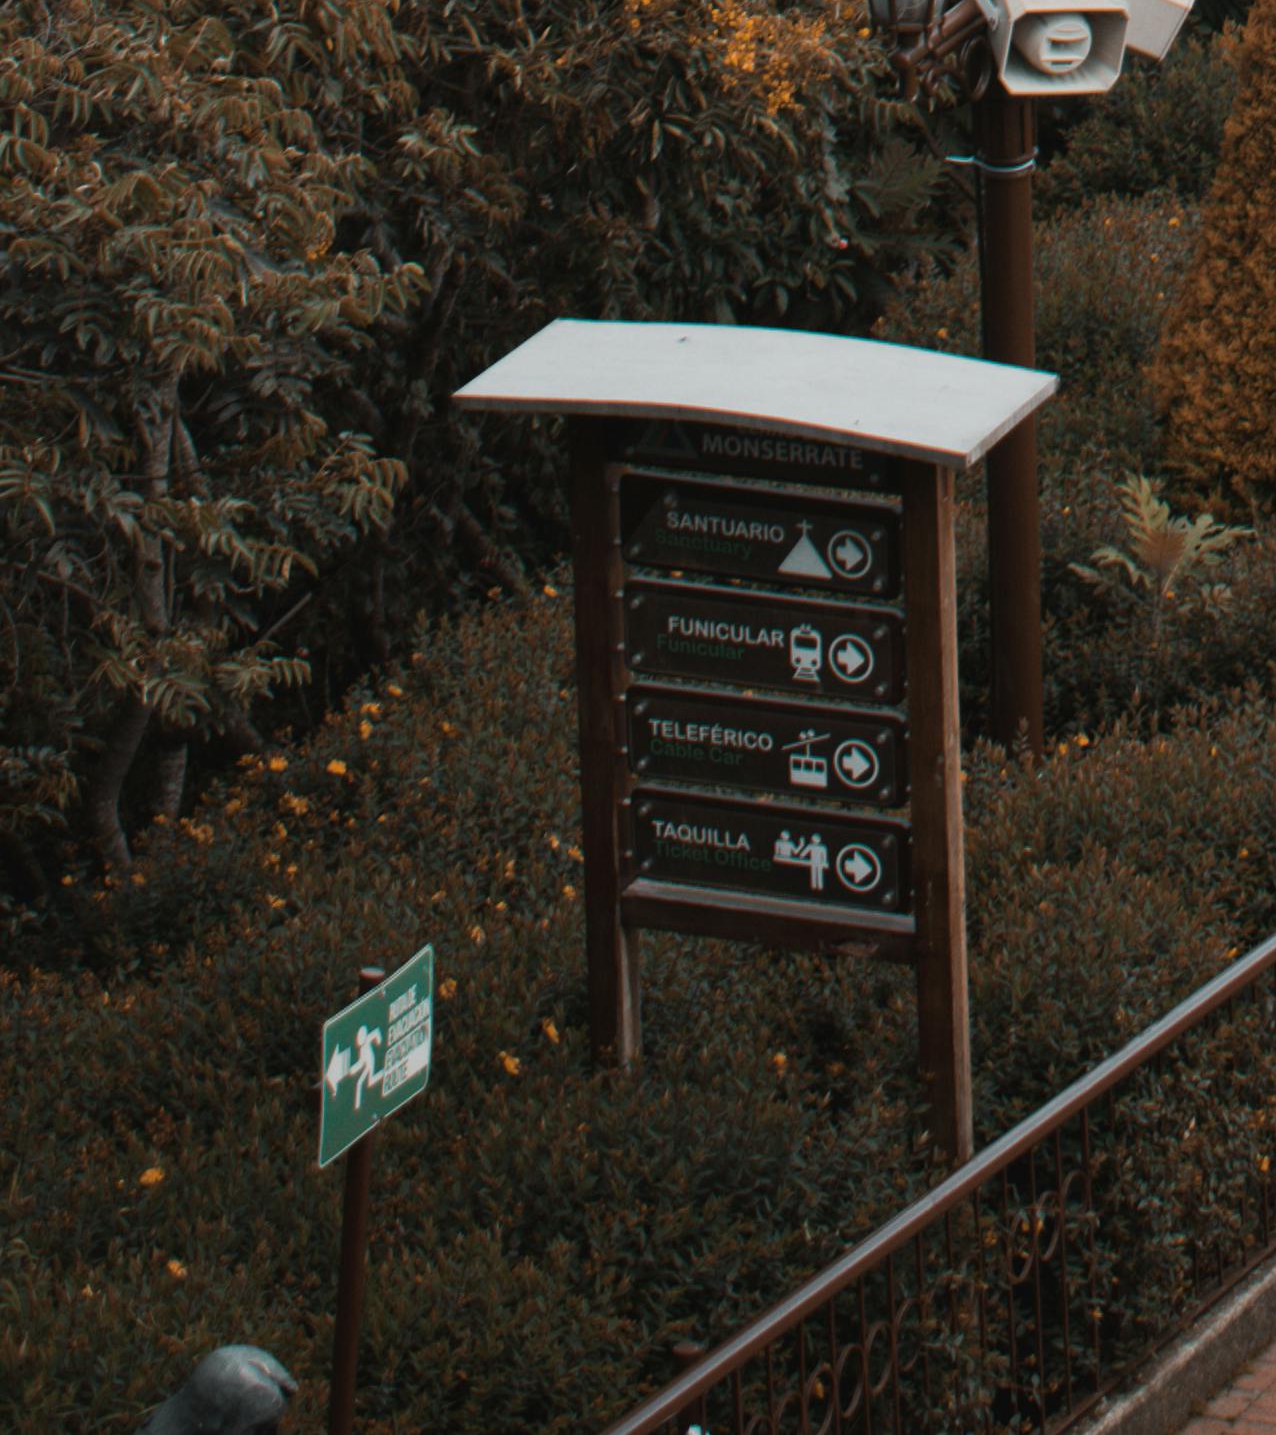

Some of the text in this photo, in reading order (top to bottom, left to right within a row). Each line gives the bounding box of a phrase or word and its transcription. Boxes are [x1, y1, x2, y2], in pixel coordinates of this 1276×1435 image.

[702, 432, 865, 470] MONSERRATE
[655, 527, 752, 559] Sanctuary
[666, 510, 785, 543] SANTUARIO
[656, 633, 746, 661] Funicular
[668, 615, 785, 647] FUNICULAR
[648, 717, 774, 752] TELEFÉRICO
[650, 738, 745, 767] Cable Car
[651, 819, 751, 852] TAQUILLA
[654, 840, 773, 873] Ticket Office
